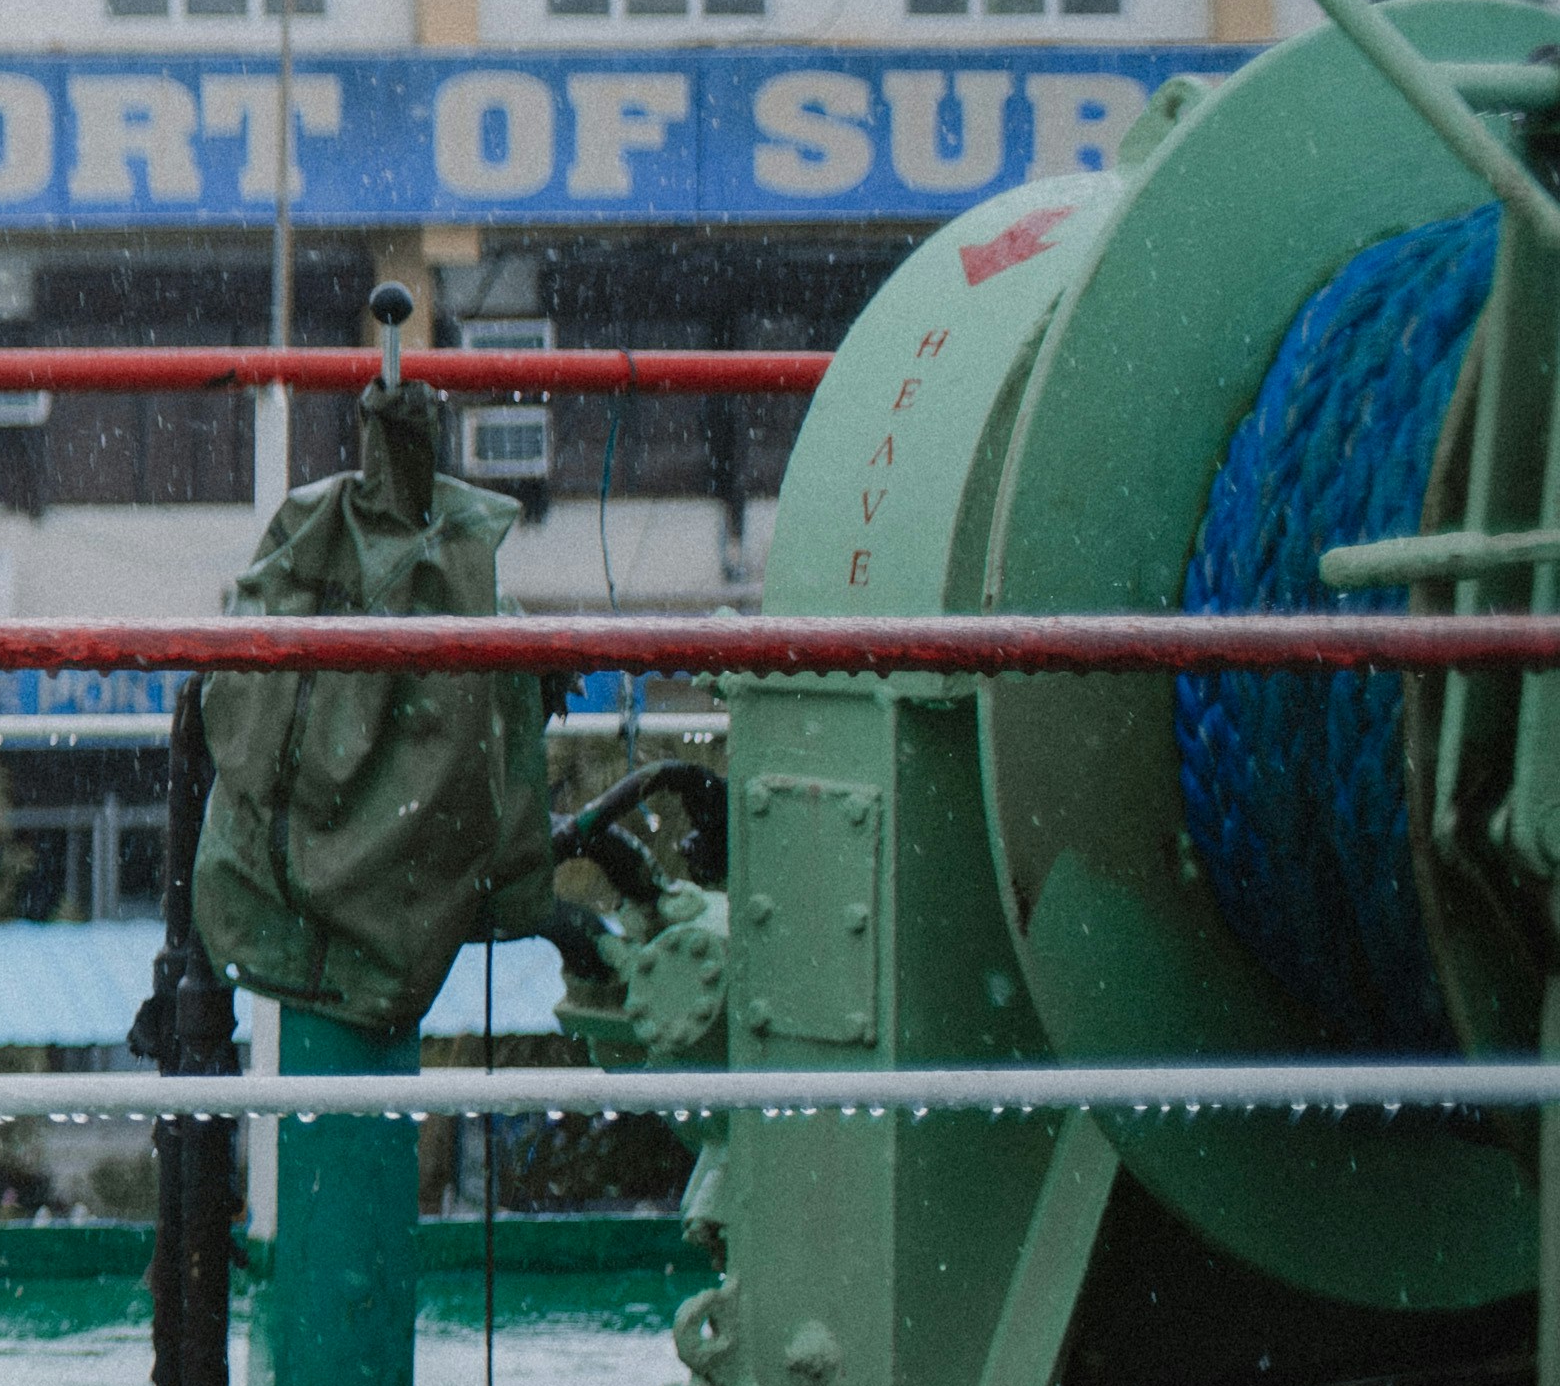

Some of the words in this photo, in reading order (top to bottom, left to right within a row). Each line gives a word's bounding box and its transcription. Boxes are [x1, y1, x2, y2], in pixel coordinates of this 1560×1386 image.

[432, 69, 691, 202] OF
[752, 69, 1234, 199] SUR
[848, 329, 951, 587] HEAVE
